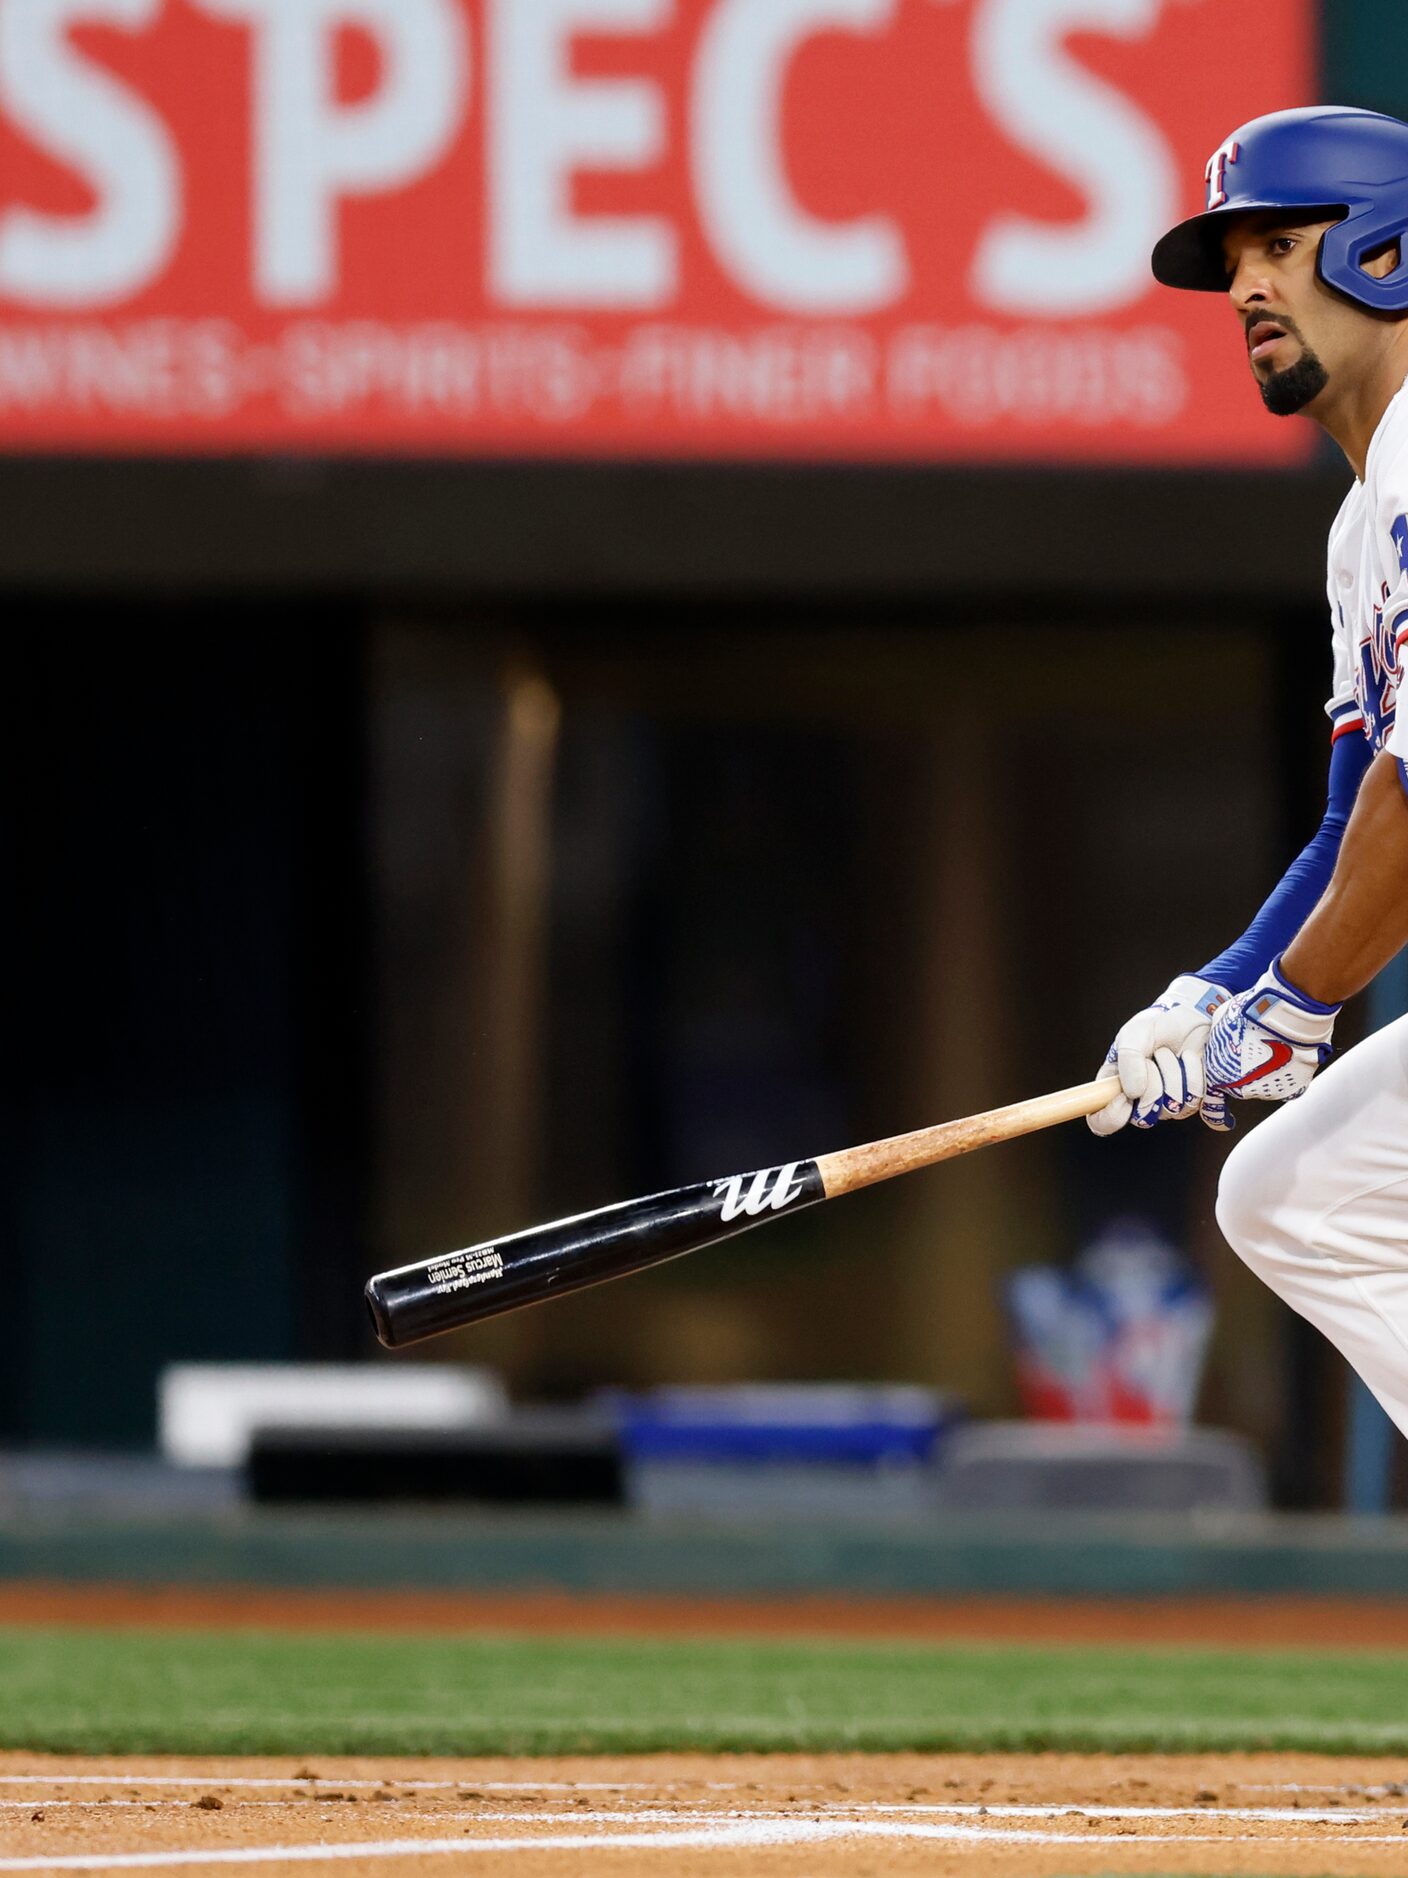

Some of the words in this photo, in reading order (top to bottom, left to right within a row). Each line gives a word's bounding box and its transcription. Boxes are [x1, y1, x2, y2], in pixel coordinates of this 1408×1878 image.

[0, 0, 1184, 314] SPECS
[1204, 141, 1240, 211] T
[427, 1264, 466, 1283] Semien
[465, 1252, 503, 1272] Marcus
